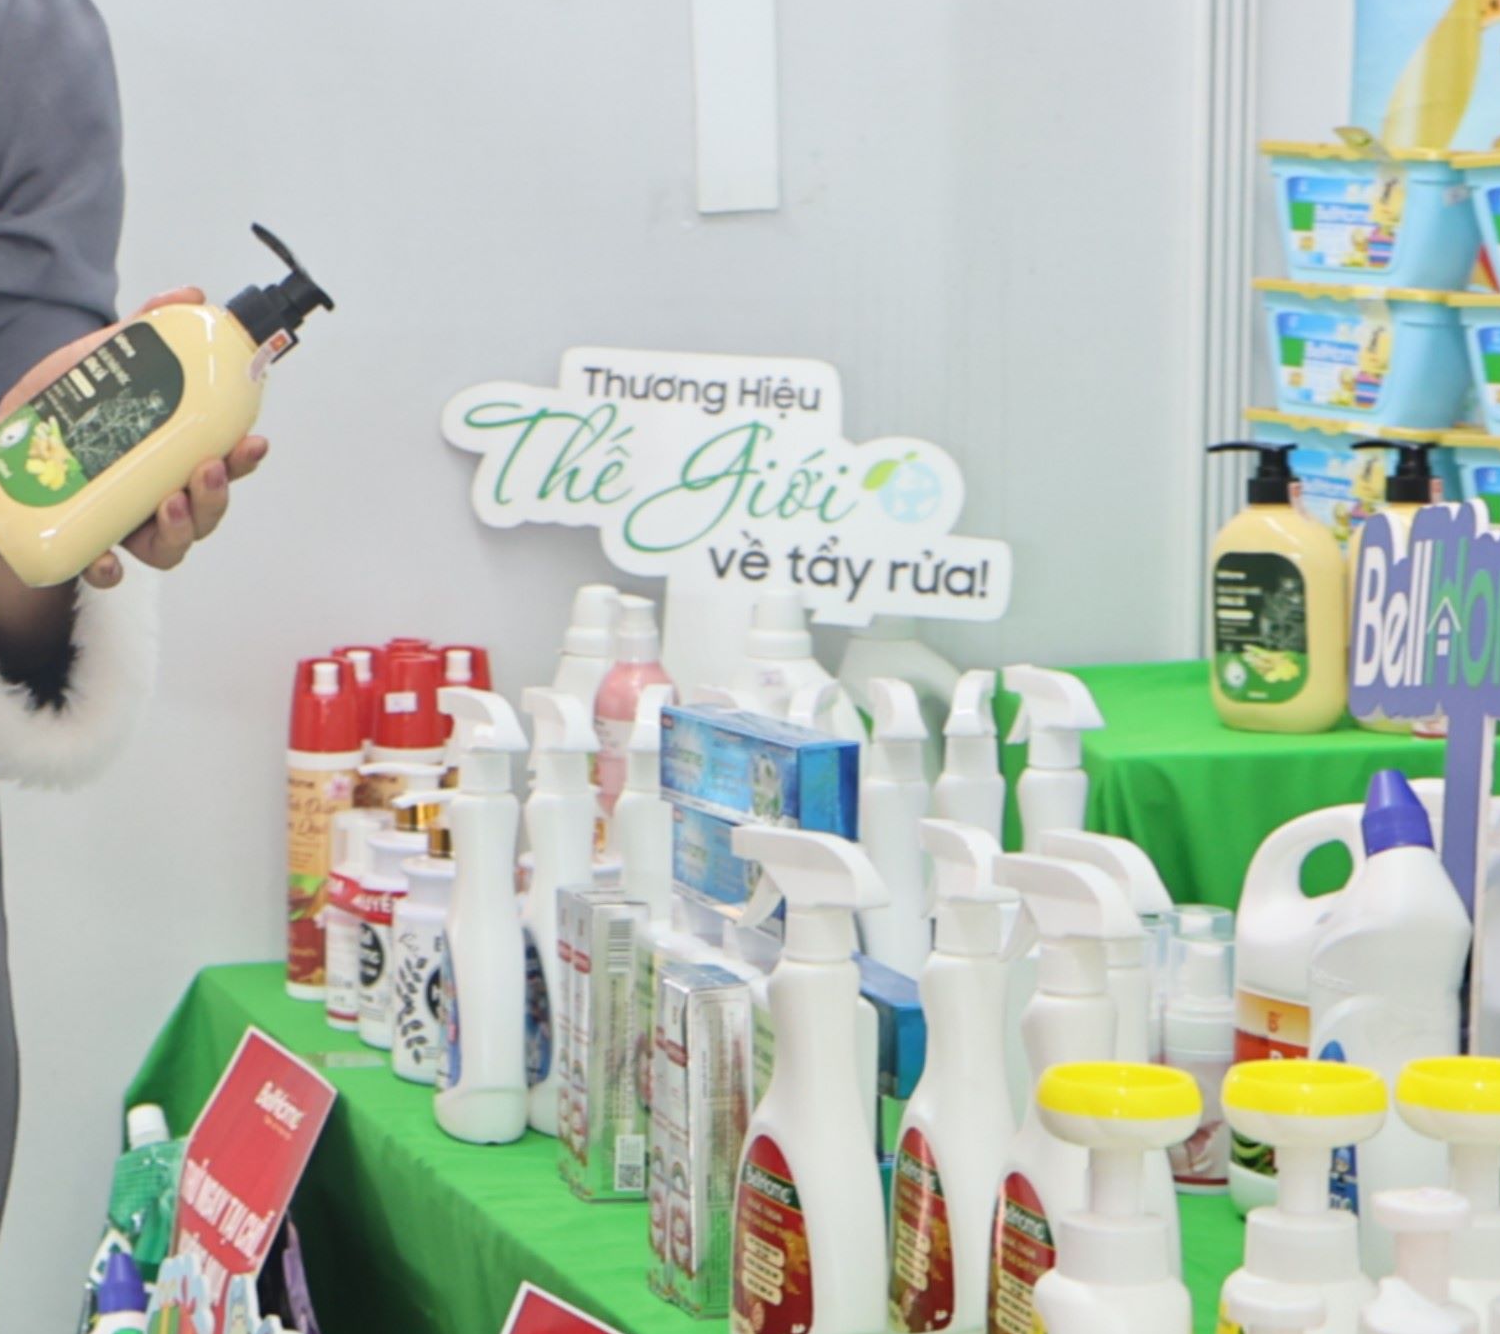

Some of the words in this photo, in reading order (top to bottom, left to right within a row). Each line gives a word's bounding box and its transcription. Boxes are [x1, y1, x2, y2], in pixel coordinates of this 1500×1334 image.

[582, 365, 729, 415] Thương
[736, 371, 822, 419] Hiệu
[463, 400, 636, 506] Thế
[622, 420, 858, 553] Giới
[708, 529, 773, 582] về
[786, 536, 872, 603] tẩy
[886, 549, 990, 599] rửa!
